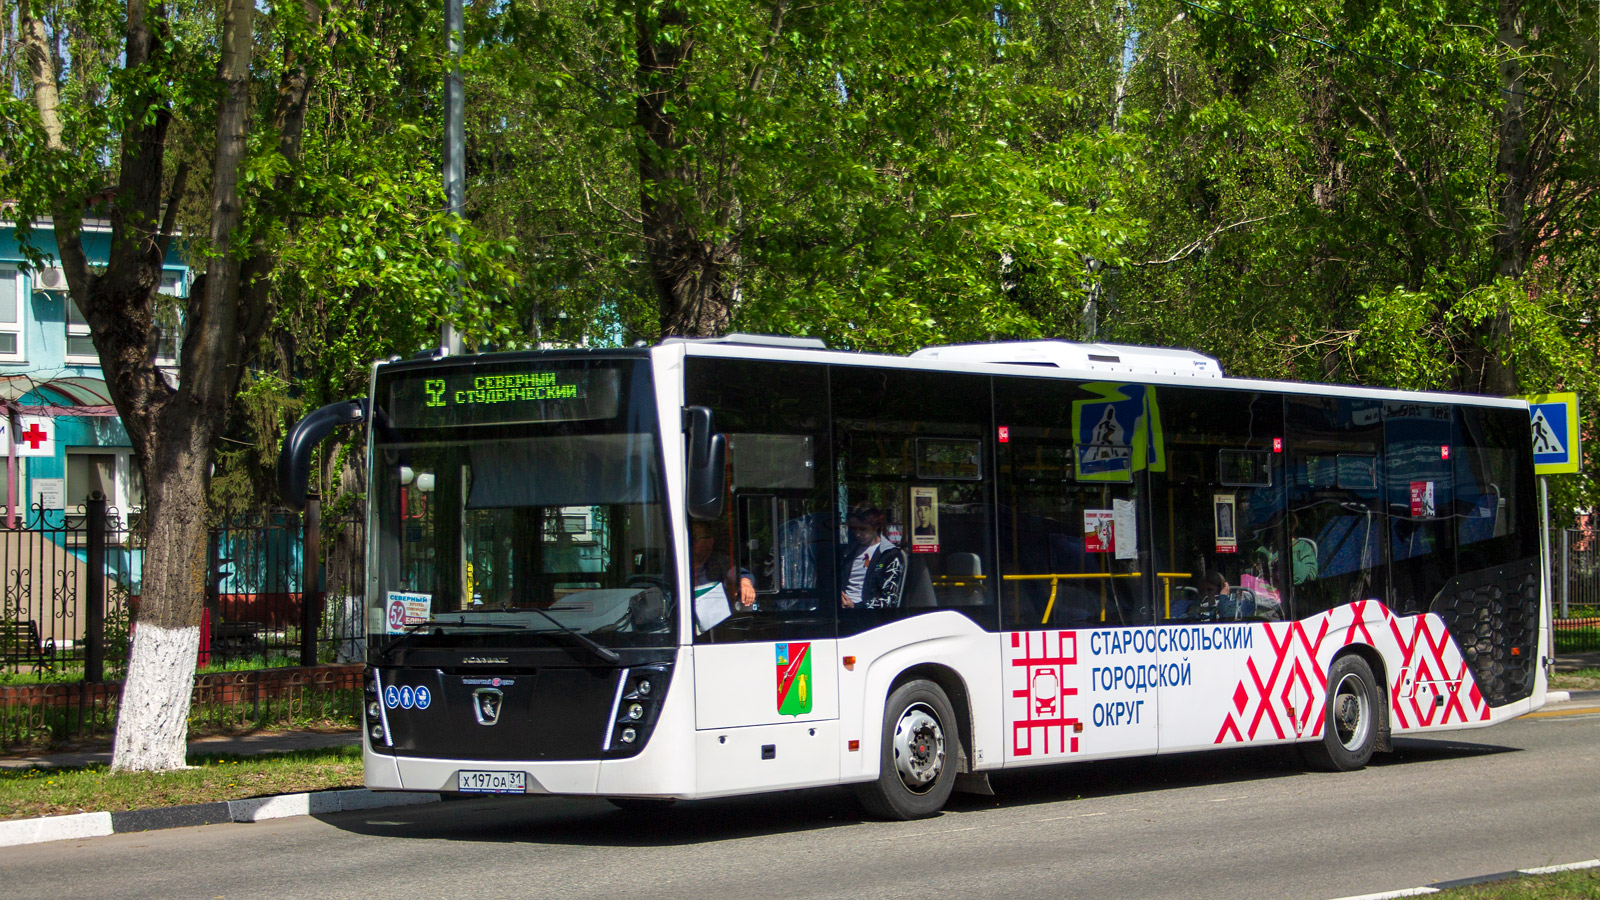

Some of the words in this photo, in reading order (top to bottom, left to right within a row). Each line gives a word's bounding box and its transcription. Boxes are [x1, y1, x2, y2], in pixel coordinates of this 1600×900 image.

[474, 372, 556, 390] СЕВЕРНЫЙ
[425, 379, 447, 407] 52
[455, 384, 577, 404] СТУДЕНЧЕСКИЙ
[390, 594, 427, 602] СЕВЕРНЫЙ
[390, 605, 404, 626] 52
[1092, 656, 1192, 693] ГОРОДСКОЙ
[1093, 700, 1144, 728] ОКРУГ
[510, 773, 521, 784] 31
